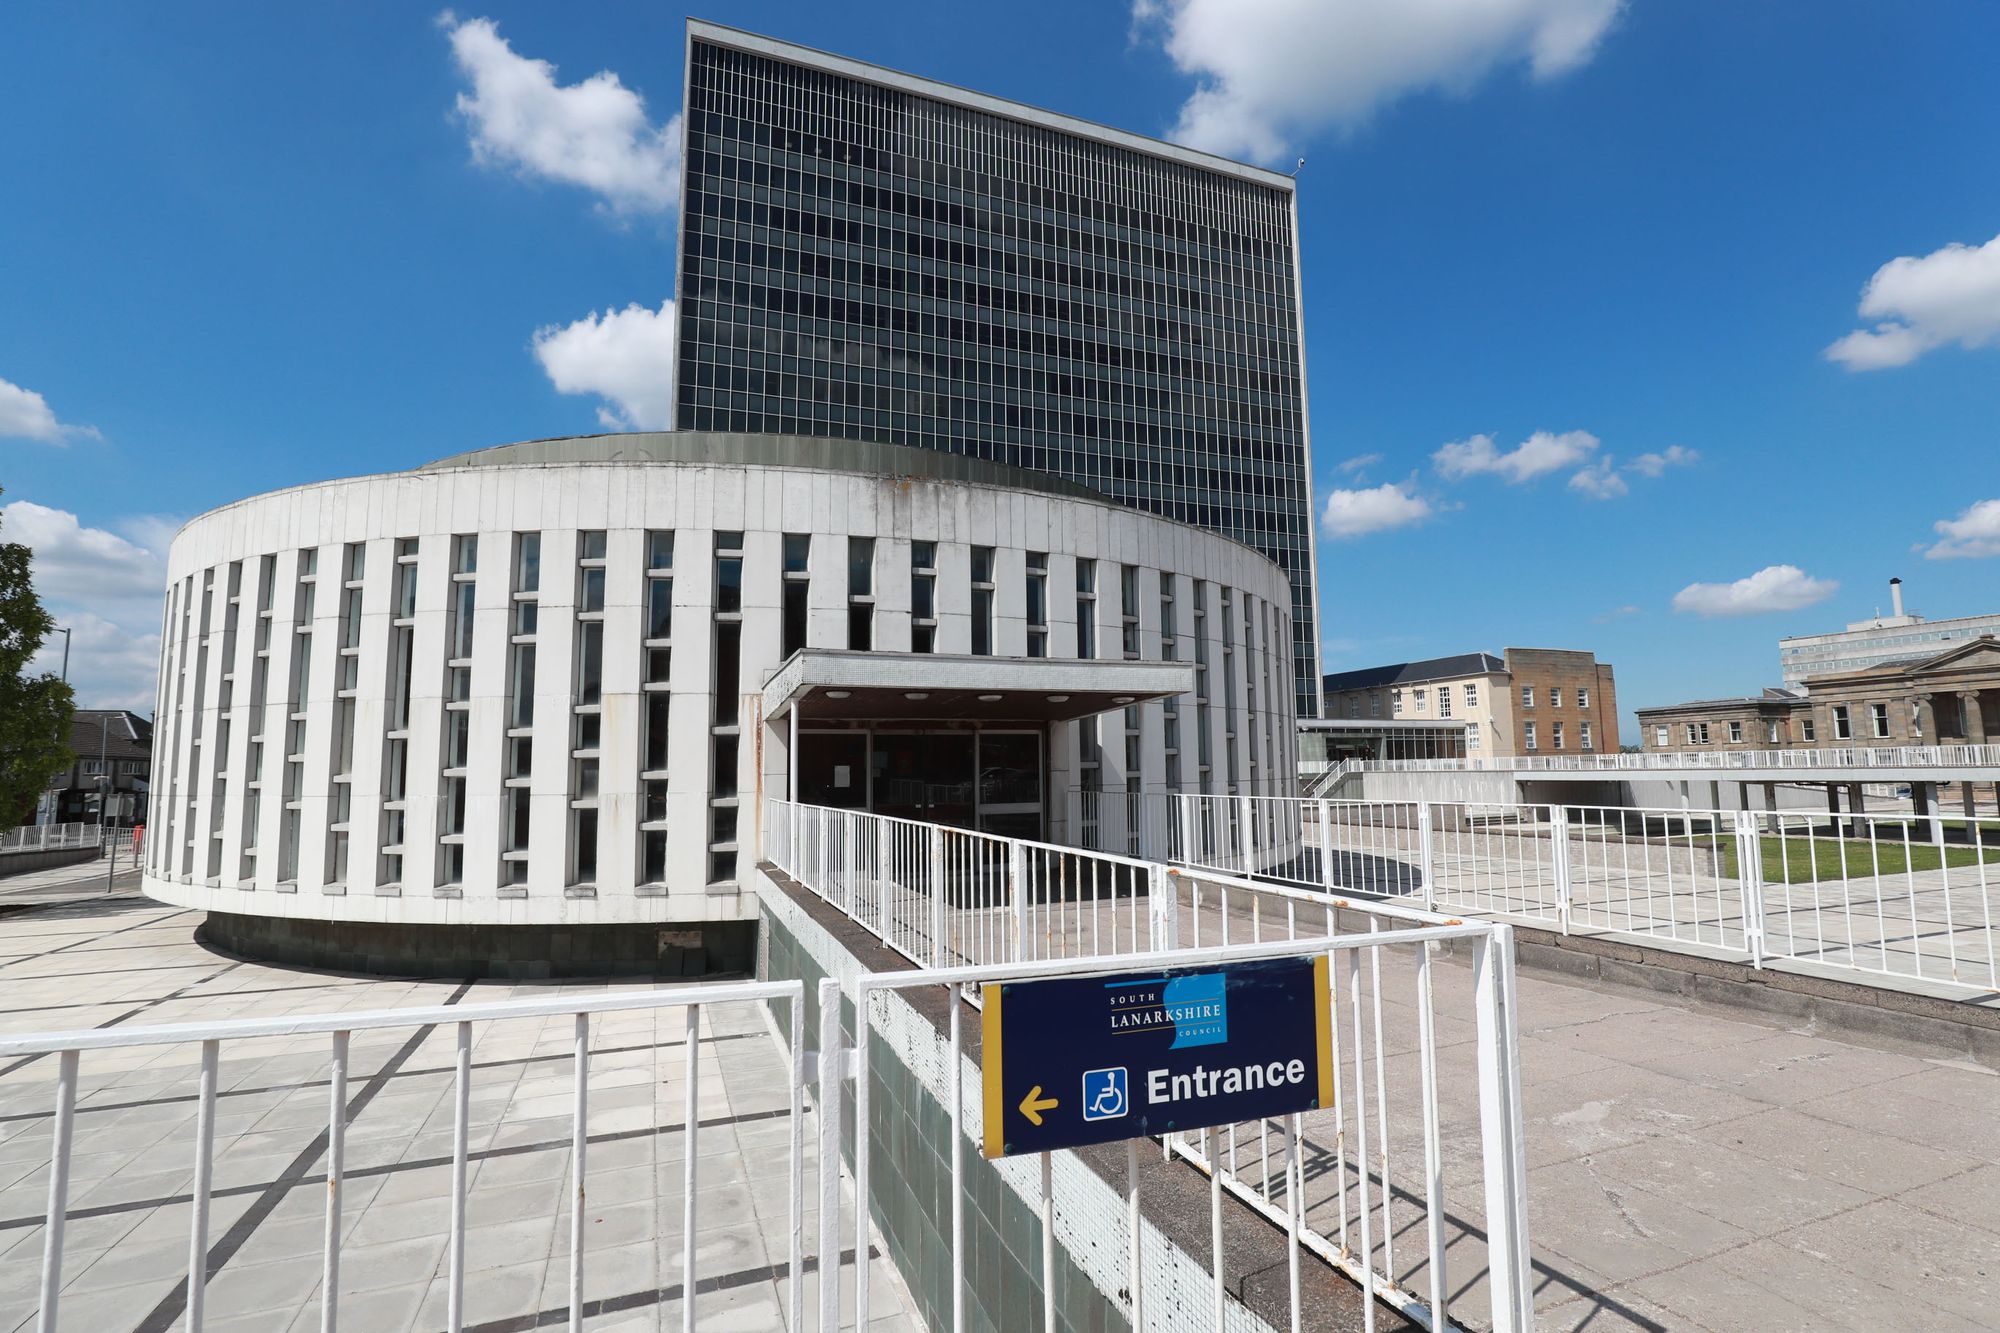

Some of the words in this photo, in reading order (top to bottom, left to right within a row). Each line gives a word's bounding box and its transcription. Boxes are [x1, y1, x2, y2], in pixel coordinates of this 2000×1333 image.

[1110, 993, 1155, 1005] SOUTH
[1111, 1004, 1221, 1028] LANARKSHIRE
[1179, 1027, 1222, 1037] COUNCIL
[1147, 1058, 1305, 1104] Entrance
